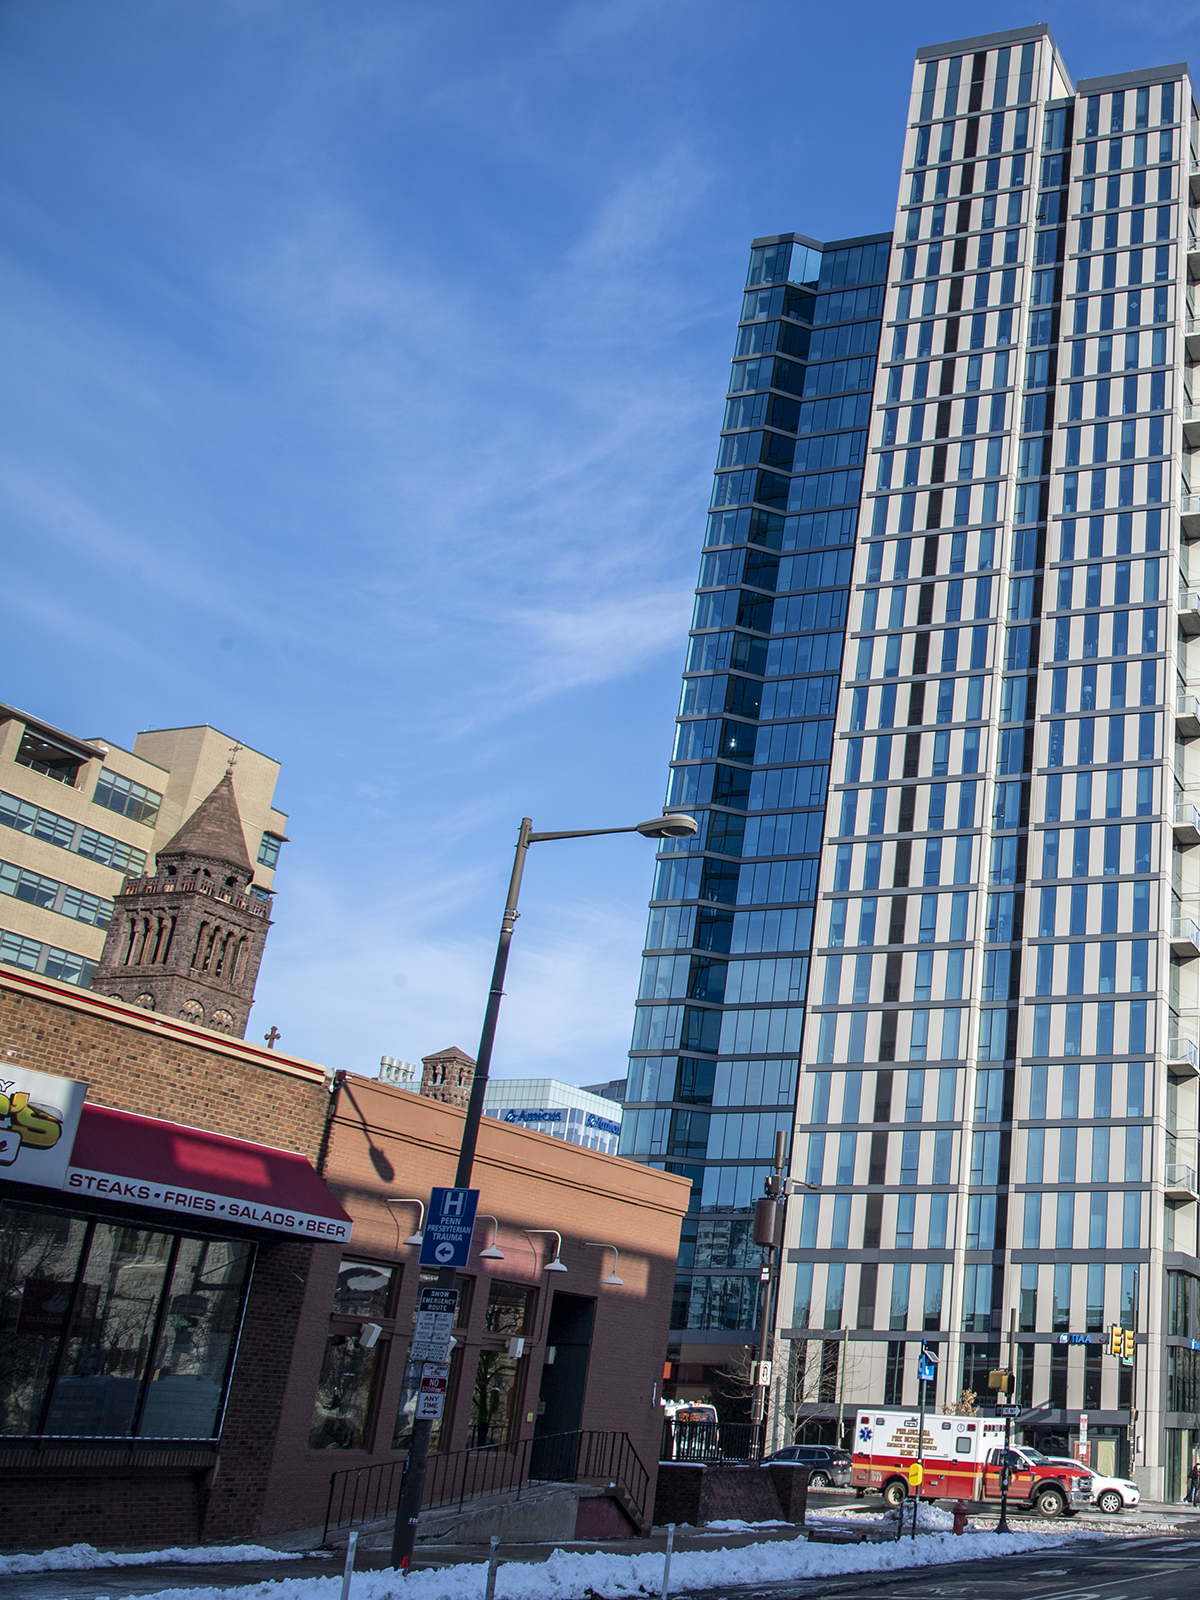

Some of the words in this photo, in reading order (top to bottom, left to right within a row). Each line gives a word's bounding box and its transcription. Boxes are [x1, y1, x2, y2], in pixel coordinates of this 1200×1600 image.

[518, 1109, 562, 1122] Amicus
[69, 1174, 150, 1199] STEAKS
[164, 1191, 216, 1212] FRIES
[228, 1203, 295, 1227] SALADS
[306, 1219, 346, 1237] BEER
[443, 1191, 464, 1215] H
[440, 1217, 461, 1225] PENN
[427, 1224, 471, 1233] PRESBYTERIAN
[432, 1232, 462, 1241] TRAUMA
[422, 1297, 456, 1305] EMERGENCY
[1071, 1334, 1092, 1343] TIAA
[429, 1379, 439, 1387] NO
